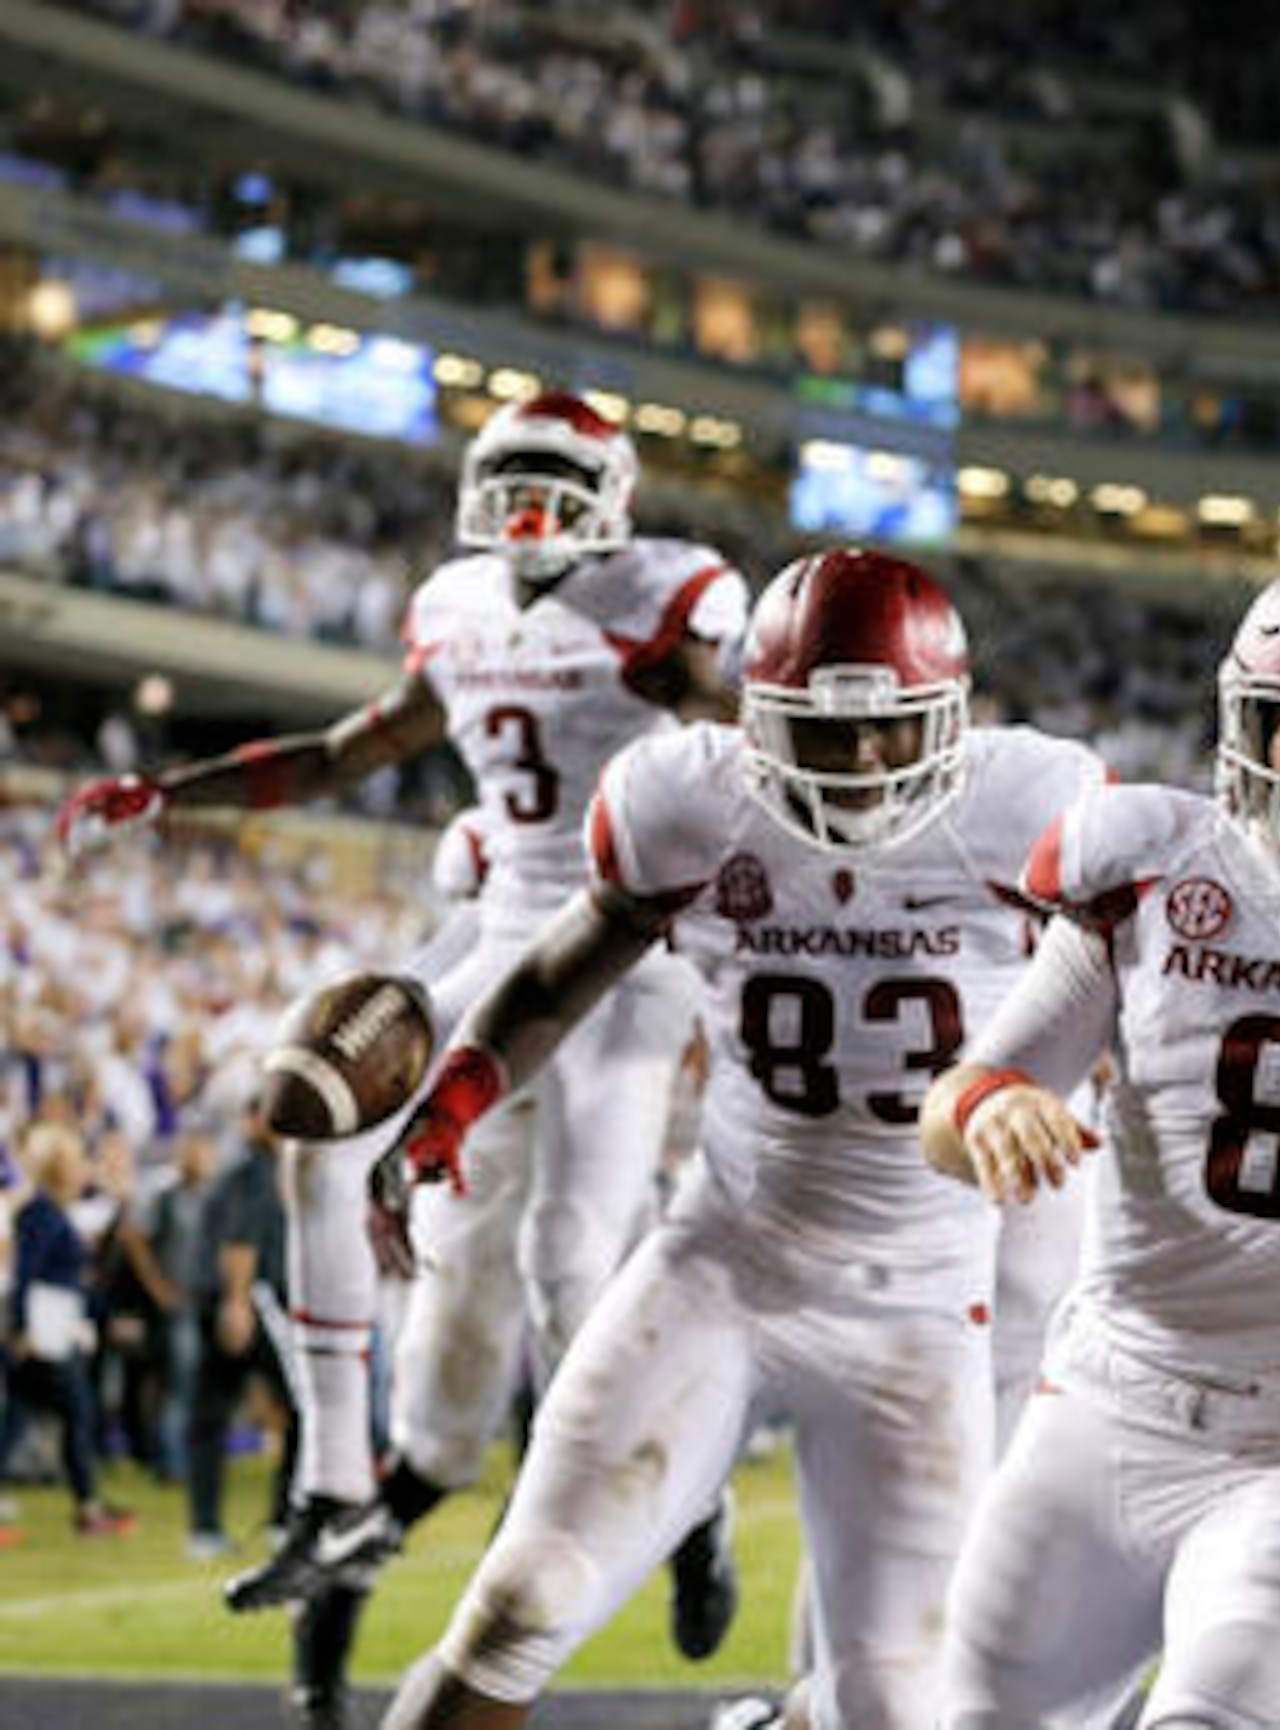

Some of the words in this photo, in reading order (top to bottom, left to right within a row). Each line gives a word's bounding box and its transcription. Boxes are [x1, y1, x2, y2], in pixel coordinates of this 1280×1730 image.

[484, 704, 560, 824] 3
[735, 926, 961, 958] ARKANSAS
[740, 974, 963, 1124] 83
